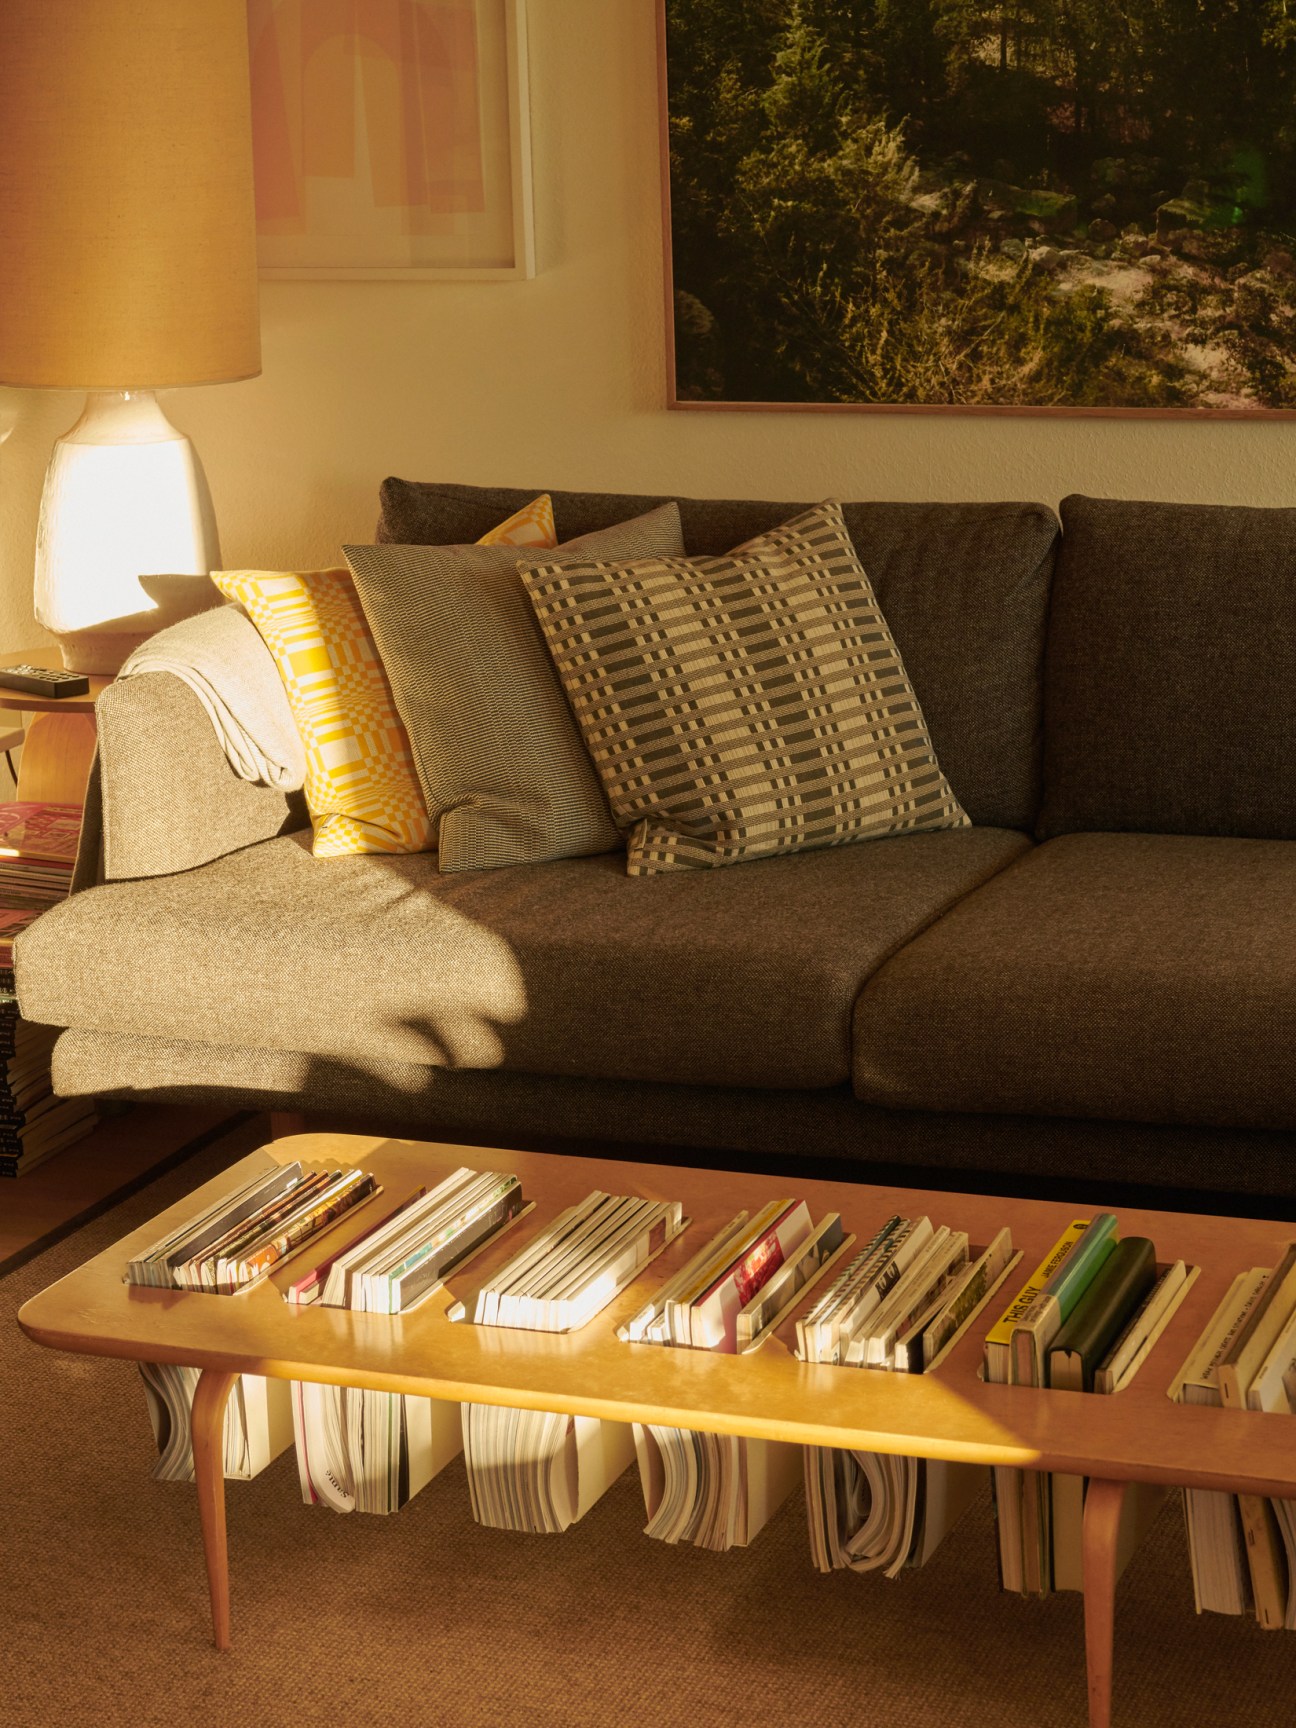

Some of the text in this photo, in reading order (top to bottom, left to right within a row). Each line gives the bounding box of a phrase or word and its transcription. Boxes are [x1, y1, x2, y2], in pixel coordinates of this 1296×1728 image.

[1041, 1241, 1073, 1278] JAMIE FERGUSON
[1003, 1304, 1028, 1323] THIS
[1018, 1286, 1041, 1304] GUY
